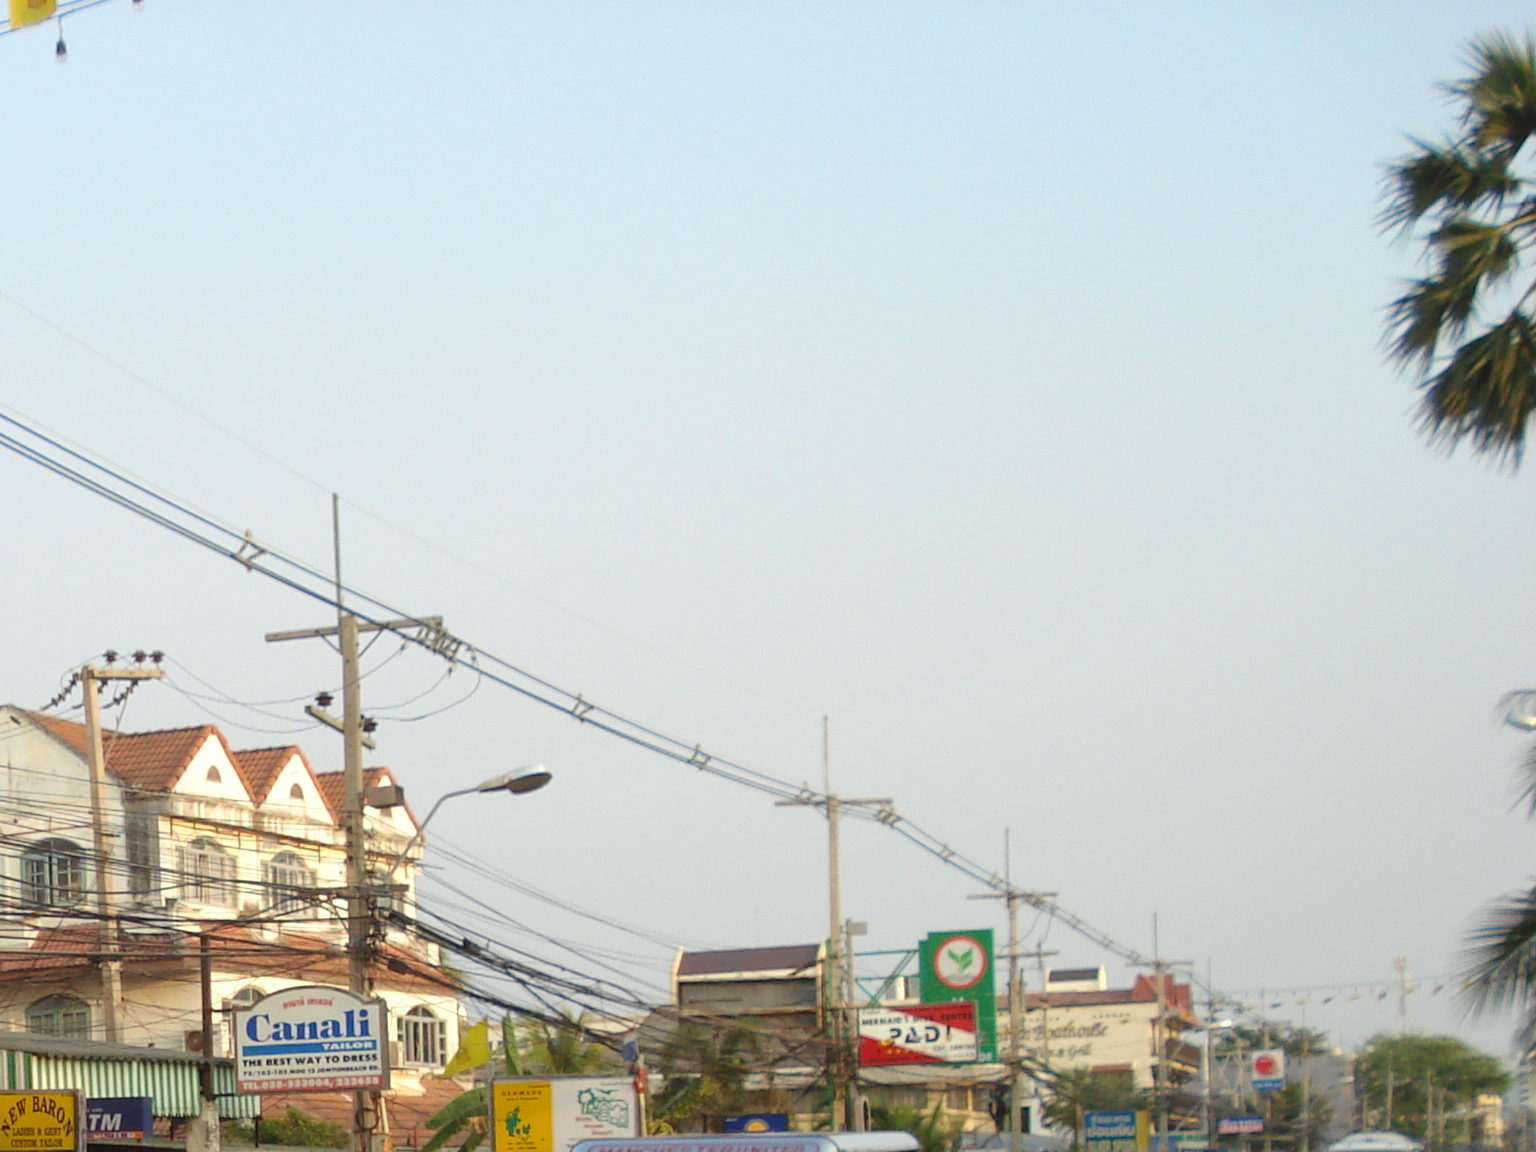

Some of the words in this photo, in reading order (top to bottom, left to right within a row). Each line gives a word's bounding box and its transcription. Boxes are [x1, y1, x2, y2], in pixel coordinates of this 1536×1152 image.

[246, 1009, 372, 1043] Canali
[322, 1041, 373, 1050] TAILOR
[266, 1058, 291, 1066] BEST
[295, 1057, 321, 1065] WAY
[343, 1054, 378, 1062] DRESS
[1, 1098, 26, 1138] NEW
[32, 1096, 73, 1137] BARON
[86, 1113, 122, 1131] TM
[45, 1127, 61, 1135] GENT
[11, 1139, 36, 1147] CUSTOM
[40, 1138, 63, 1147] TAILOR
